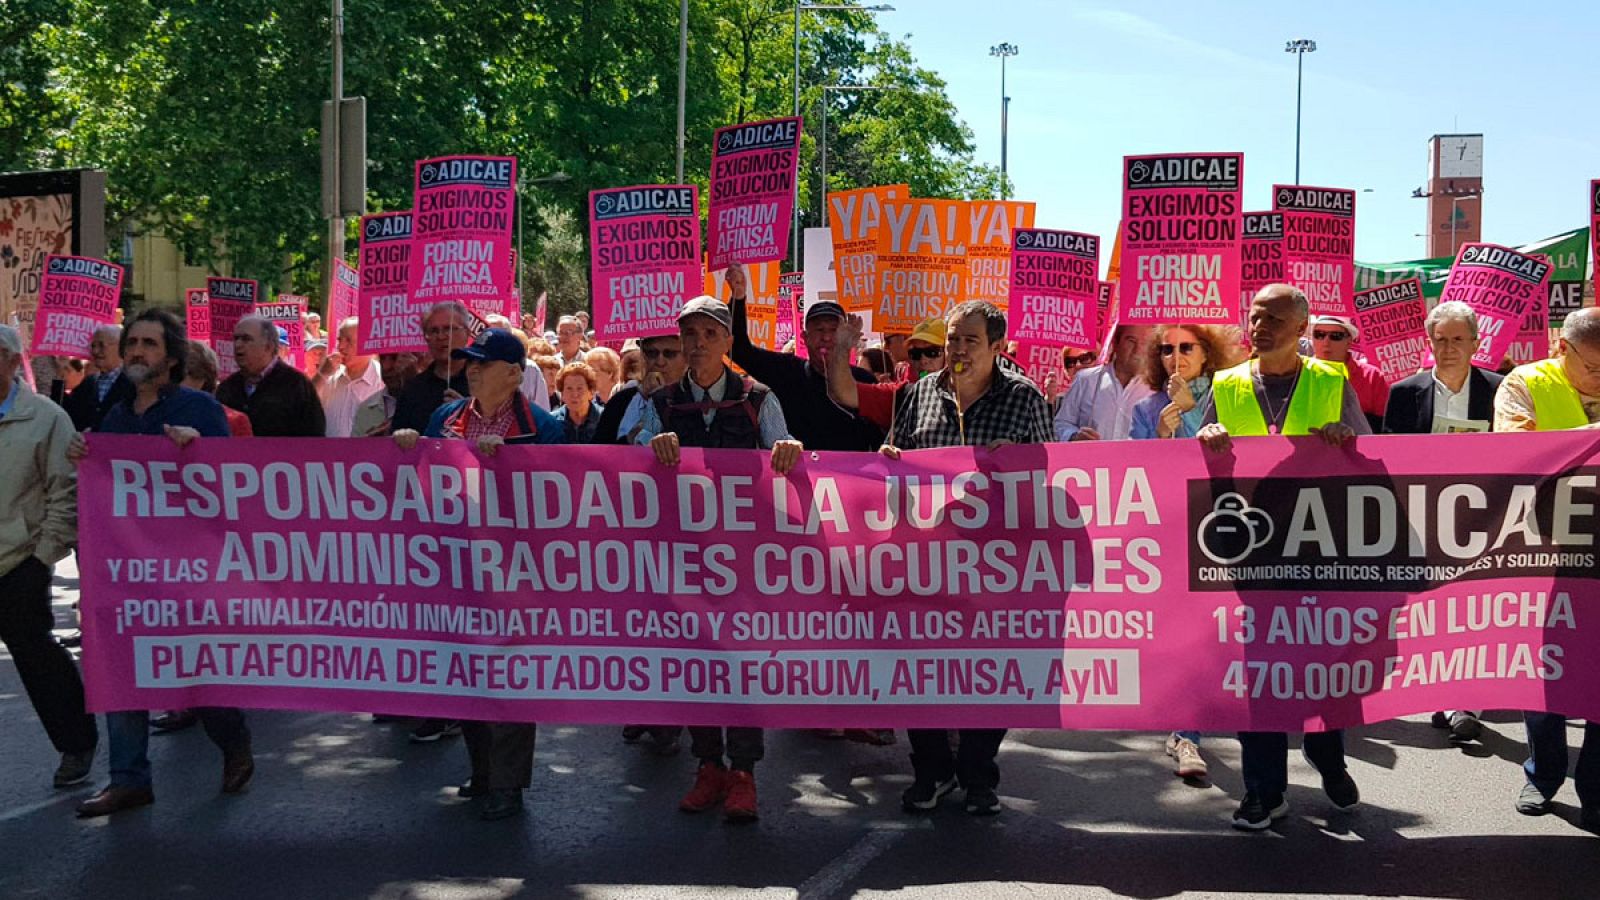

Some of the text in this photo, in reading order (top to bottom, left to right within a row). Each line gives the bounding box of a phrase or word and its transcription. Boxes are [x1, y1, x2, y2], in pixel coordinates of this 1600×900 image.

[732, 121, 797, 148] ADICAE
[437, 160, 510, 181] ADICAE
[715, 151, 792, 179] EXIGIMOS
[1151, 158, 1237, 181] ADICAE
[714, 173, 791, 200] SOLUCION
[419, 189, 507, 212] EXIGIMOS
[616, 189, 692, 212] ADICAE
[1128, 193, 1235, 217] EXIGIMOS
[1294, 190, 1353, 210] ADICAE
[381, 216, 412, 235] ADI
[417, 210, 507, 234] SOLUCION
[718, 202, 778, 231] FORUM
[831, 191, 896, 241] YA
[1242, 215, 1283, 233] CAE
[1287, 215, 1351, 237] XIGIMOS
[597, 220, 692, 244] EXIGIMOS
[716, 224, 774, 254] AFINSA
[883, 203, 958, 256] YA!
[1127, 218, 1236, 242] SOLUCION
[423, 240, 494, 265] FORUM
[598, 241, 694, 266] SOLUCION
[1034, 232, 1096, 253] ADICAE
[1287, 235, 1351, 255] OLUCION
[64, 259, 119, 281] ADICAE
[841, 254, 876, 277] FOR
[970, 258, 1012, 277] ORU
[1015, 254, 1094, 277] EXIGIMOS
[1137, 253, 1222, 280] FORUM
[1241, 262, 1284, 281] CION
[1478, 246, 1547, 278] ADICAE
[363, 267, 409, 287] SOLU
[421, 262, 493, 287] AFINSA
[609, 272, 685, 299] FORUM
[843, 274, 875, 298] AFI
[881, 270, 959, 295] FORUM
[1014, 271, 1095, 294] SOLUCION
[1450, 270, 1534, 299] EXIGIMOS
[45, 279, 114, 301] EXIGIMOS
[414, 286, 434, 298] ARTE
[435, 286, 440, 296] Y
[440, 284, 498, 295] NATURALEZA
[965, 277, 1009, 297] FINS
[1135, 281, 1222, 306] AFINSA
[1288, 281, 1342, 303] FINSA
[1369, 281, 1418, 305] ADICAE
[43, 292, 113, 315] SOLUCION
[610, 295, 684, 322] AFINSA
[1022, 295, 1085, 319] FORUM
[1128, 307, 1229, 319] ARTE Y NATURALEZA
[1308, 302, 1346, 313] ATURALEZA
[1445, 287, 1527, 315] SOLUCION
[1020, 312, 1085, 336] AFINSA
[1360, 301, 1422, 328] EXIGIMOS
[43, 328, 90, 348] AFINS
[370, 315, 422, 339] AFINS
[604, 322, 627, 335] ARTE
[628, 321, 634, 332] Y
[1014, 330, 1035, 339] ARTE
[1041, 331, 1091, 346] NATURALEZA
[1363, 315, 1425, 341] SOLUCION
[1029, 345, 1064, 365] FOR
[1375, 336, 1425, 361] FORUM
[111, 460, 1161, 535] RESPONSABILIDAD DE LA JUSTICIA
[1281, 475, 1597, 560] ADICAE
[107, 531, 1162, 597] Y DE LAS ADMINISTRACIONES CONCURSALES
[1199, 564, 1311, 581] CONSUMIDORES
[1315, 561, 1384, 582] CRÍTICOS,
[1495, 555, 1504, 568] Y
[1507, 552, 1595, 568] SOLIDARIOS
[116, 593, 1154, 640] ¡POR LA FINALIZACIÓN INMEDIATA DEL CASO Y SOLUCIÓN A LOS AFECTADOS!
[1212, 591, 1577, 646] 13 AÑOS EN LUCHA
[151, 643, 1119, 704] PLATAFORMA DE AFECTADOS POR FÓRUM, AFINSA, AyN
[1222, 643, 1565, 700] 470.000 FAMILIAS
